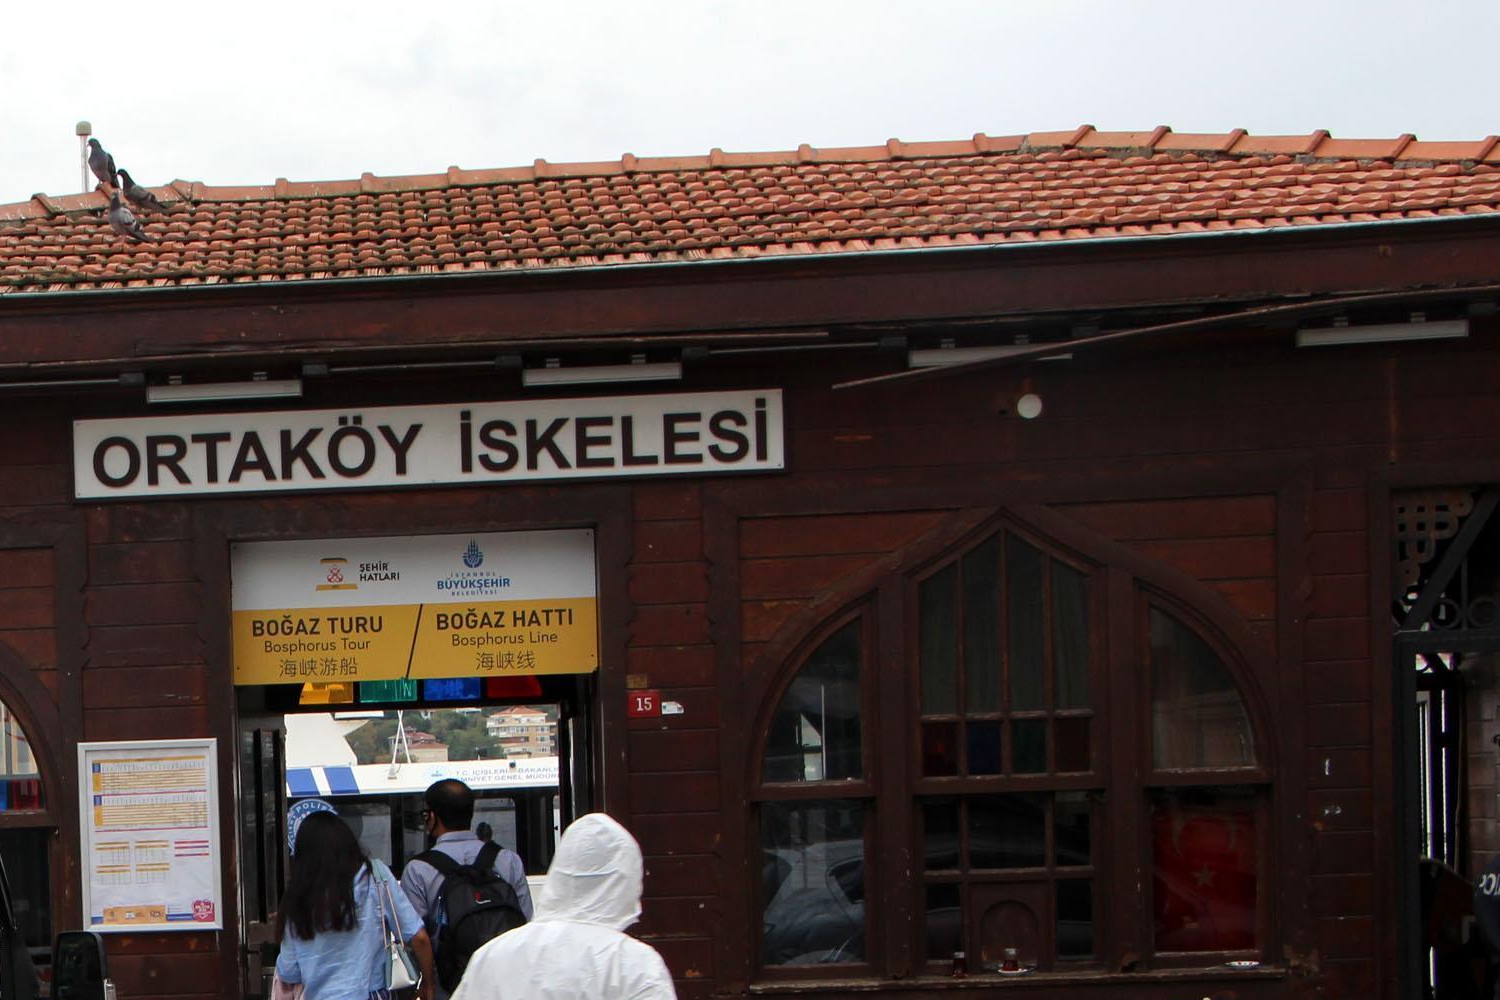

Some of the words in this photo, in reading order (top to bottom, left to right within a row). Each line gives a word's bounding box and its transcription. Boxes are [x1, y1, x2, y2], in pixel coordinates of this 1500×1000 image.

[91, 415, 423, 488] ORTAKÖY
[460, 398, 769, 473] İSKELESİ
[359, 560, 389, 573] ŞEHİR
[450, 570, 496, 578] İSTANBUL
[359, 571, 400, 582] HATLARI
[437, 576, 510, 592] BÜYÜKŞEHİR
[252, 614, 321, 638] BOĞAZ
[327, 615, 383, 635] TURU
[436, 608, 505, 631] BOĞAZ
[512, 608, 573, 628] HATTI
[264, 639, 336, 656] Bosphorus
[341, 637, 371, 650] Tour
[452, 632, 524, 649] Bosphorus
[529, 630, 558, 644] Line
[279, 656, 359, 678] 海峡游船
[476, 650, 536, 671] 海峡线
[636, 697, 652, 712] 15
